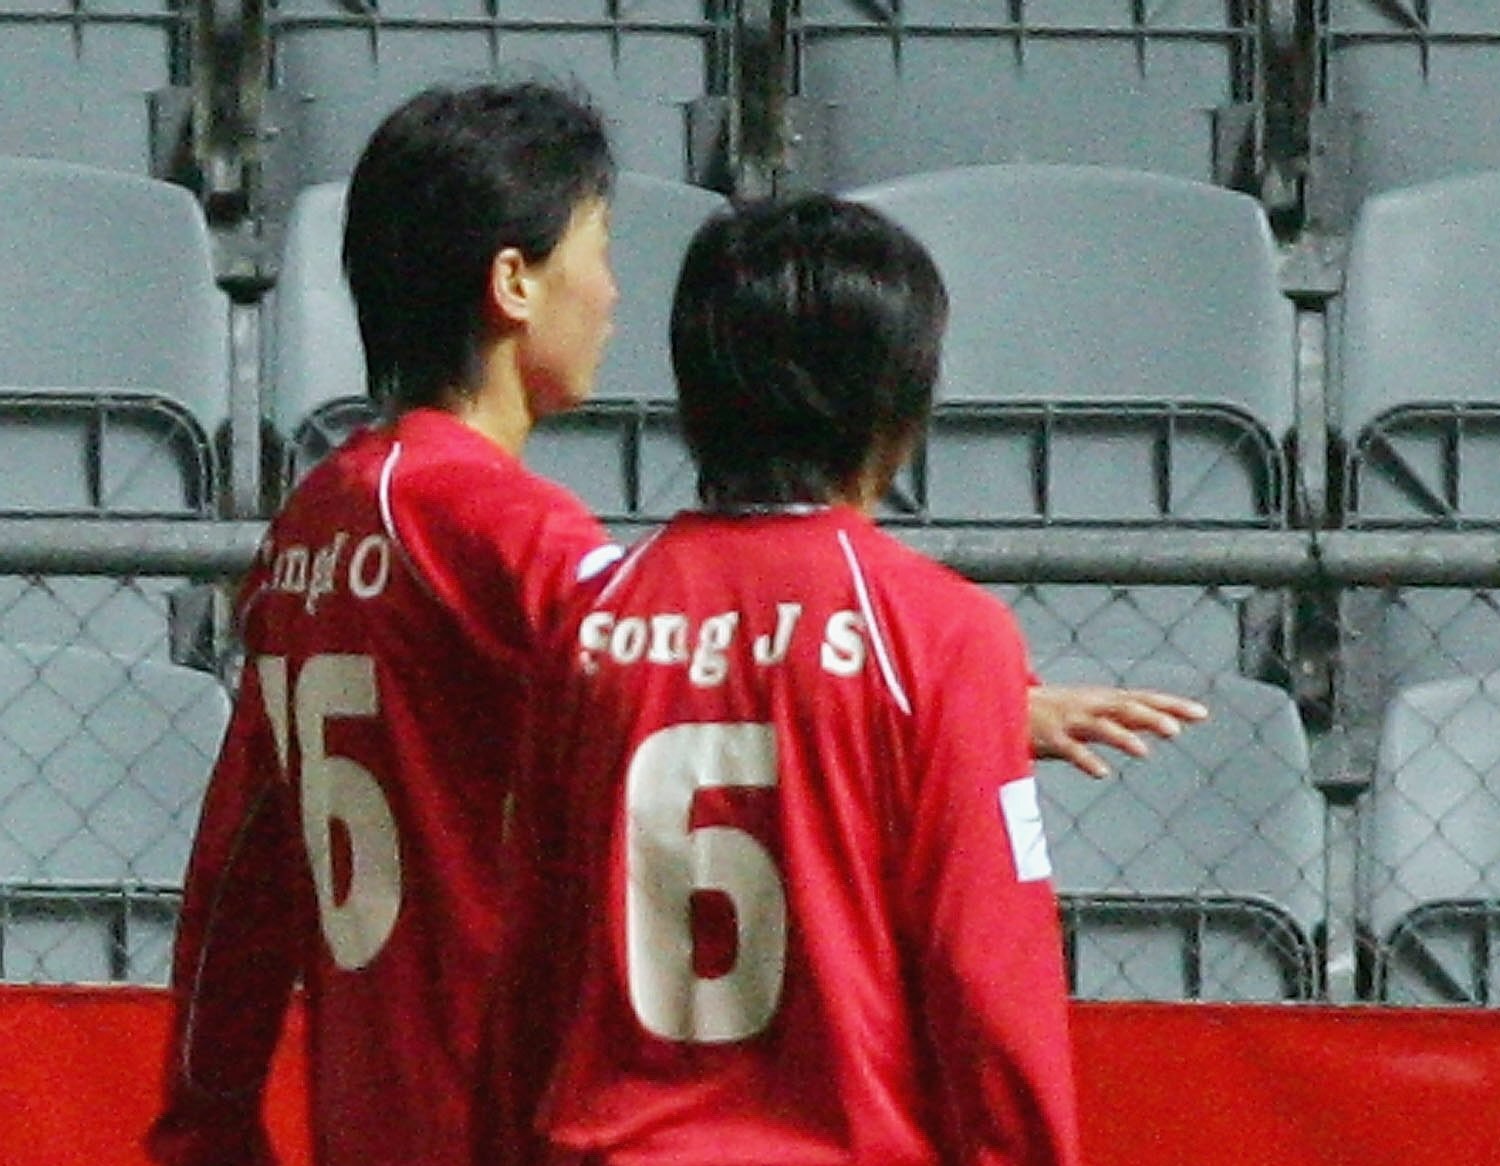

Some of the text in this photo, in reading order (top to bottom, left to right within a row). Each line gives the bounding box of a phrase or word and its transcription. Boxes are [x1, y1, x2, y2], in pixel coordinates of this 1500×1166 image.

[350, 533, 390, 599] O
[753, 602, 802, 666] J
[821, 609, 867, 677] S
[626, 722, 789, 1044] 6
